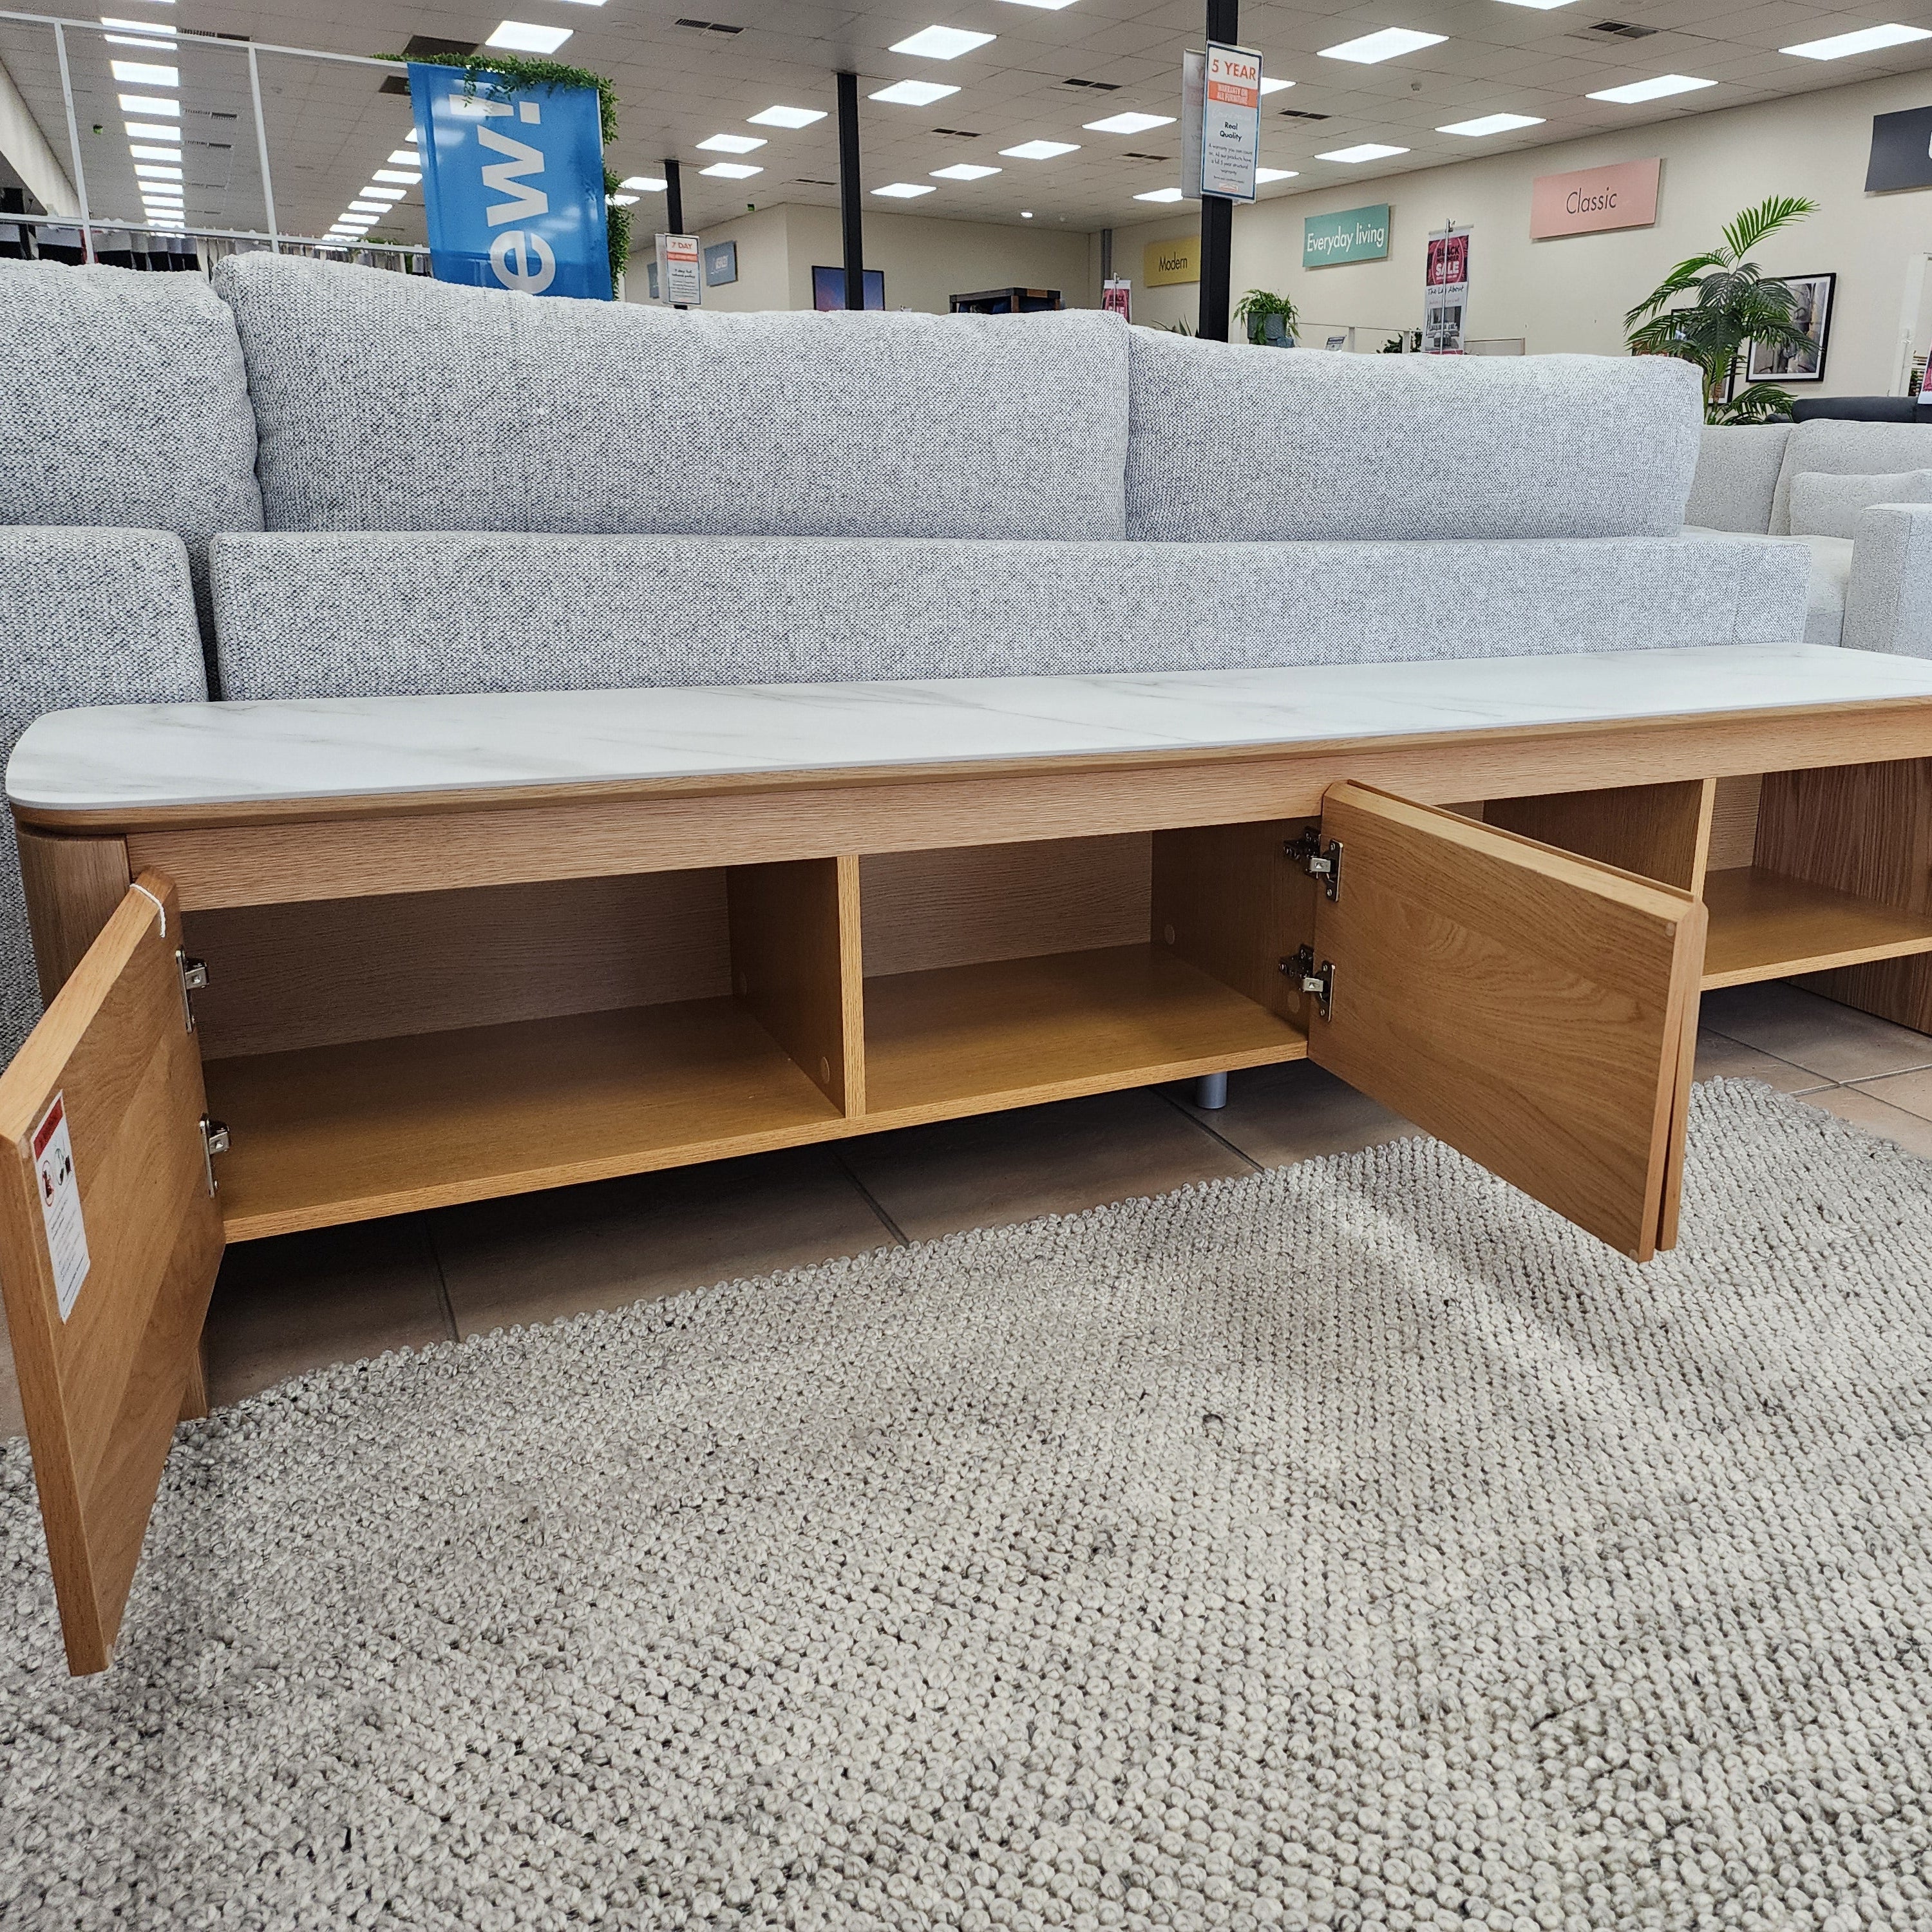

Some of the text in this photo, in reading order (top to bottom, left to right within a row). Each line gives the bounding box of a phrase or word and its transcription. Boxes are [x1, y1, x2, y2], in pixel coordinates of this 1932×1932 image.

[1212, 59, 1219, 73] 5
[1224, 61, 1256, 80] YEAR
[1220, 130, 1242, 142] Quality
[1224, 122, 1238, 131] Real
[1566, 186, 1617, 214] Classic
[1307, 222, 1385, 255] Everyday living
[1159, 252, 1188, 272] Modern
